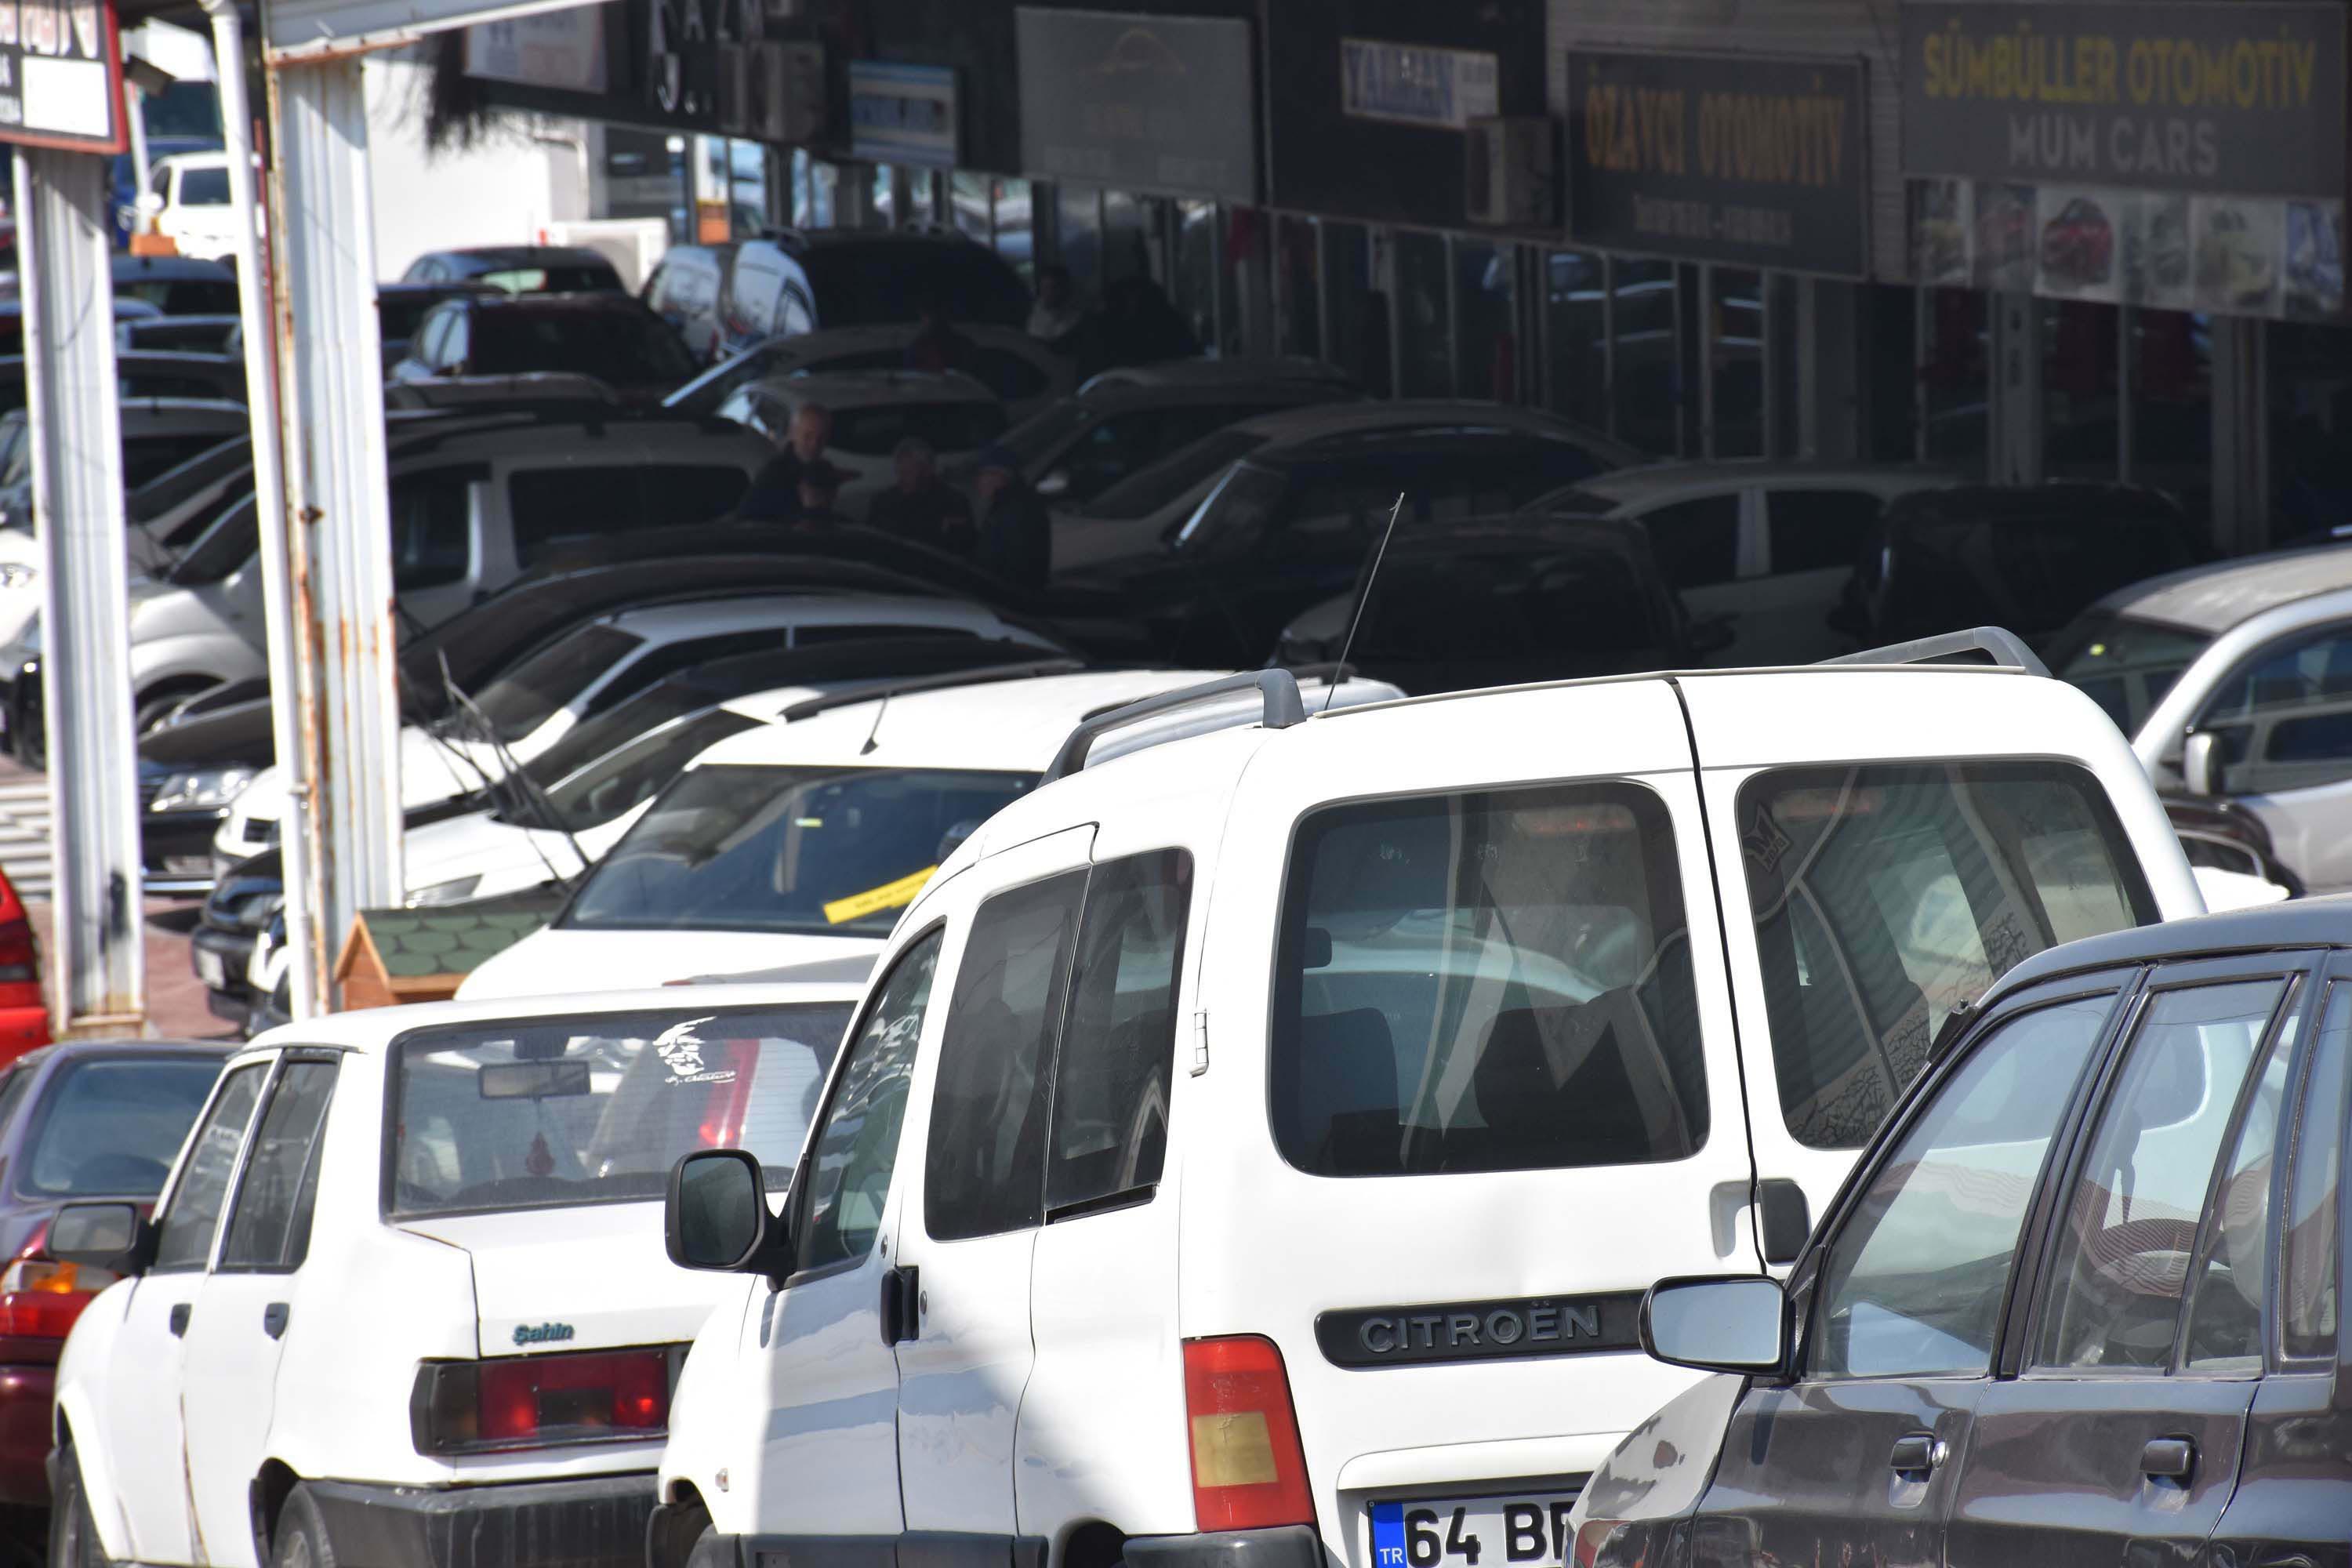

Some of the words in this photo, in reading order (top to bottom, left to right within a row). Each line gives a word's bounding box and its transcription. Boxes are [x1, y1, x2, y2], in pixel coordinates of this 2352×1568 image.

[1923, 15, 2118, 103] SÜMBÜLLER
[2127, 23, 2314, 110] OTOMOTİV
[1697, 71, 1846, 187] OTOMOTİV
[2009, 114, 2097, 170] MUM
[2111, 117, 2218, 176] CARS
[513, 1322, 575, 1347] Şahin
[1360, 1299, 1600, 1353] CITROËN
[1380, 1548, 1403, 1565] TR
[1404, 1506, 1481, 1568] 64
